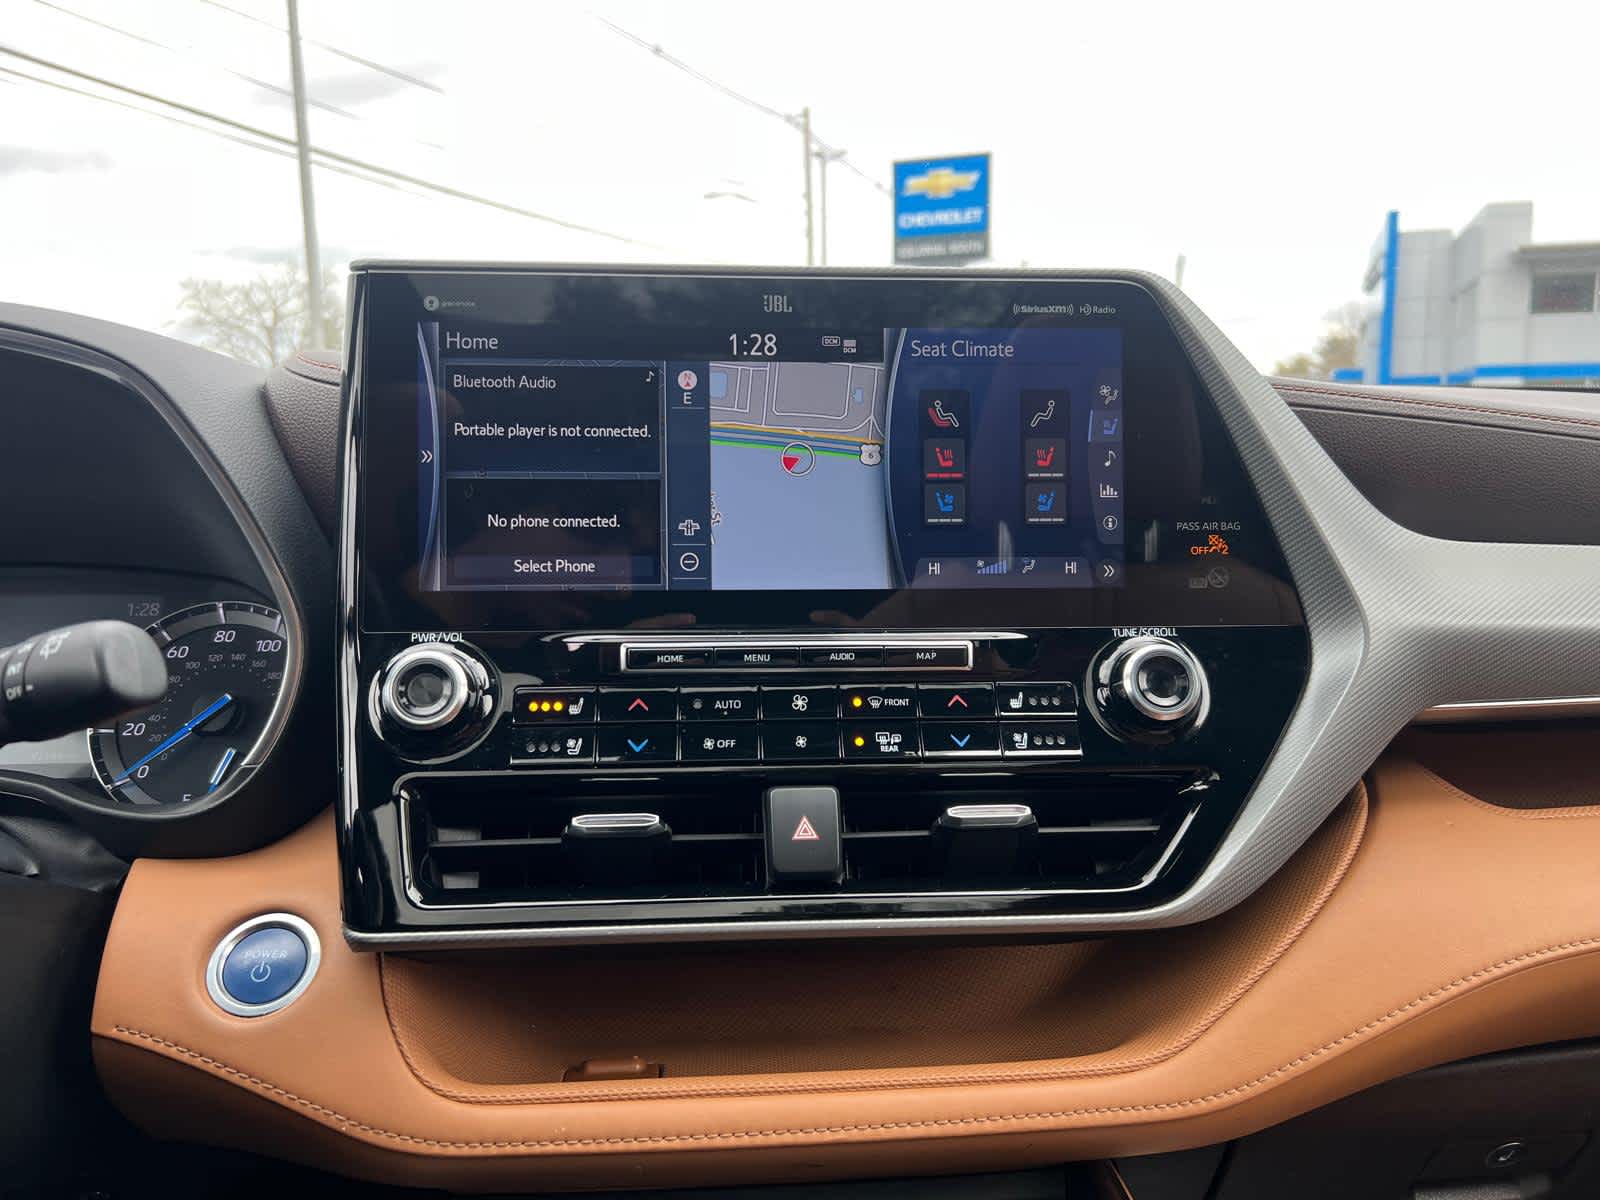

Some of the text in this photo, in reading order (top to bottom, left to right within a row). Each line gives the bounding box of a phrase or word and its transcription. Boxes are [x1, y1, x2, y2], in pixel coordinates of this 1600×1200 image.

[764, 295, 793, 312] JBL
[1093, 305, 1116, 314] Radio
[445, 332, 499, 350] Home
[729, 333, 777, 356] 1:28
[911, 340, 1014, 357] Seat Climate
[453, 374, 556, 389] Bluetooth Audio
[683, 391, 692, 404] E
[454, 422, 651, 440] Portable player is not connected.
[487, 514, 620, 530] No phone connected.
[1176, 521, 1241, 531] PASS AIR BAG
[1190, 546, 1209, 555] OFF
[514, 560, 595, 573] Select Phone
[928, 562, 941, 575] HI
[1065, 562, 1077, 574] HI
[127, 602, 160, 616] 1:28
[213, 630, 236, 642] 80
[411, 632, 465, 643] PWR/VOL
[1112, 627, 1178, 637] TUNE/SCROLL
[167, 646, 189, 659] 60
[255, 640, 281, 653] 100
[657, 654, 684, 663] HOME
[744, 653, 771, 662] MENU
[829, 652, 855, 661] AUDIO
[916, 652, 937, 660] MAP
[714, 700, 741, 709] AUTO
[884, 698, 910, 707] FRONT
[122, 723, 145, 736] 20
[716, 739, 736, 749] OFF
[137, 765, 149, 778] 0
[244, 949, 288, 959] POWER
